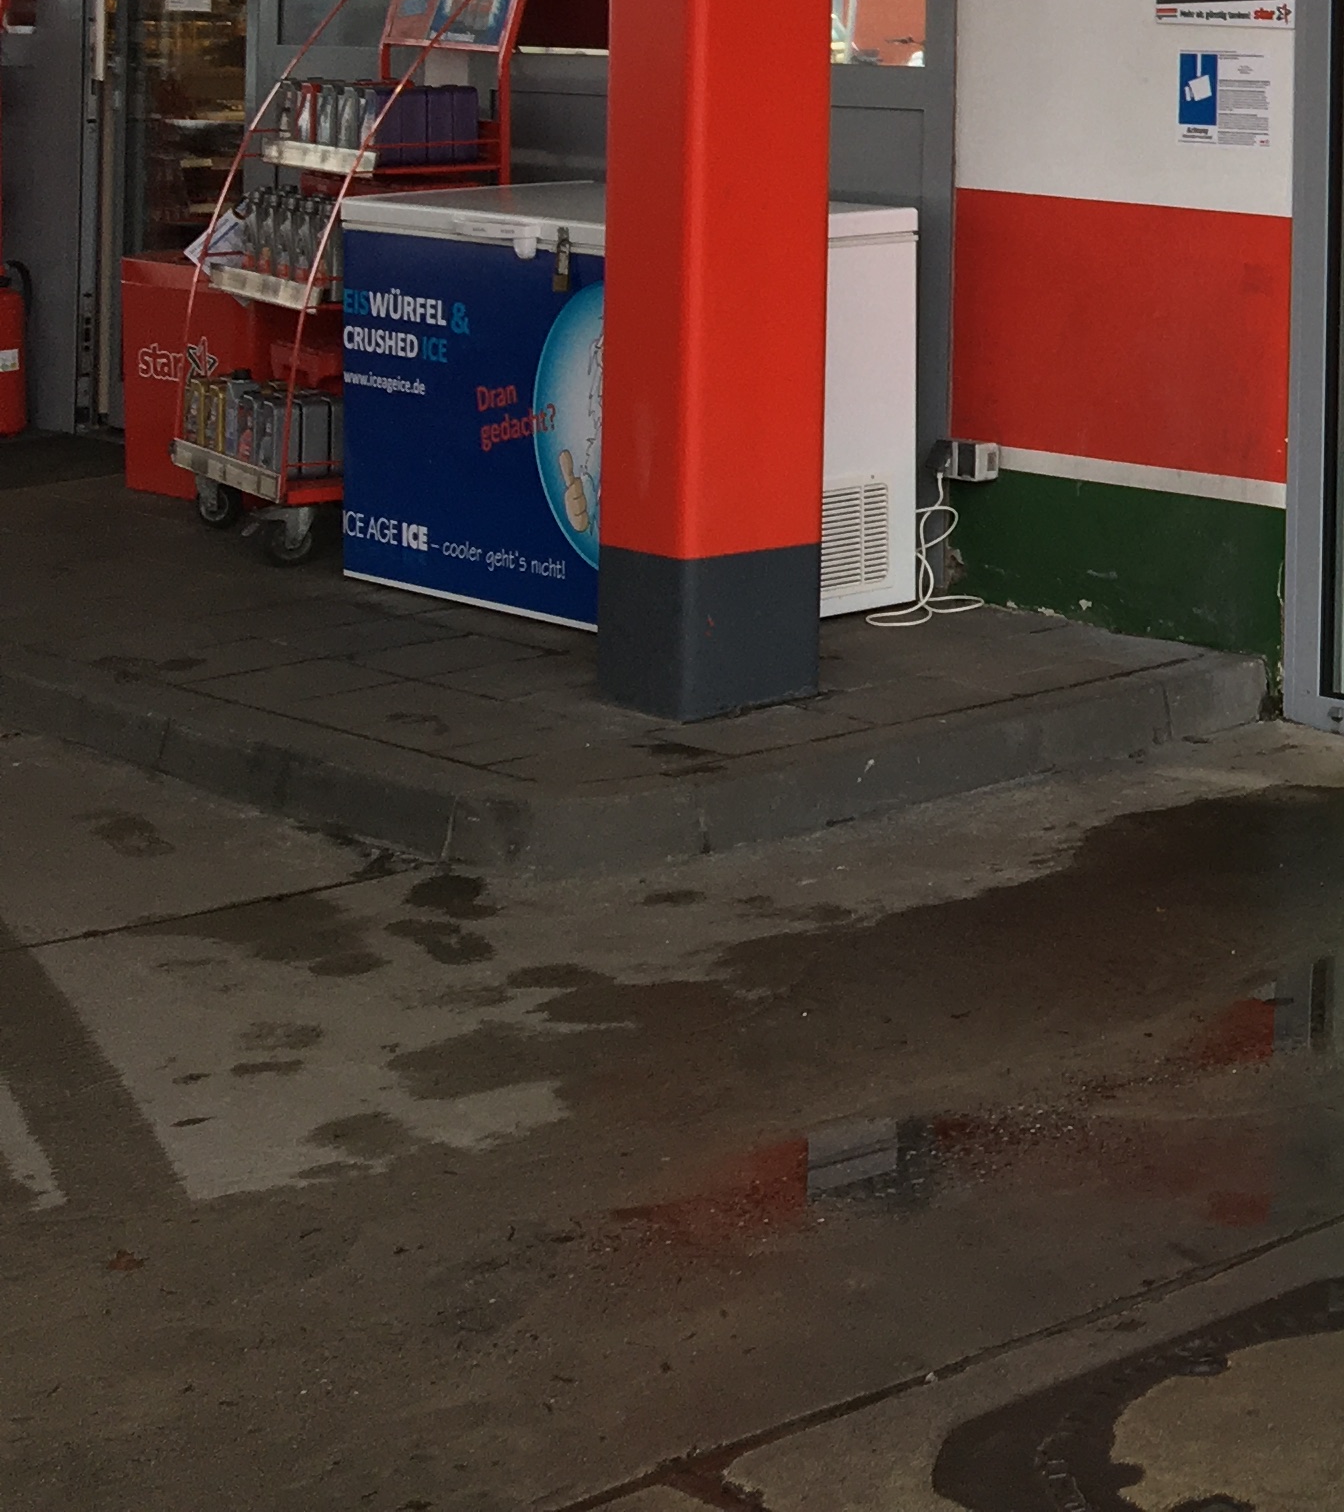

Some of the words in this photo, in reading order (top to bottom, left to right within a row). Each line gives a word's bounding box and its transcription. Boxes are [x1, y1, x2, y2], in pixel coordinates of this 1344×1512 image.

[343, 289, 447, 326] EISWÜRFEL
[451, 302, 471, 335] &
[138, 343, 183, 382] star
[343, 326, 418, 359] CRUSHED
[422, 336, 448, 364] ICE
[343, 371, 426, 395] www.iceageice.de
[475, 385, 519, 412] Dran
[480, 402, 557, 452] gedacht?
[343, 510, 364, 538] ICE
[366, 516, 399, 545] AGE
[401, 522, 428, 551] ICE
[442, 540, 482, 563] cooler
[531, 557, 566, 580] nicht!
